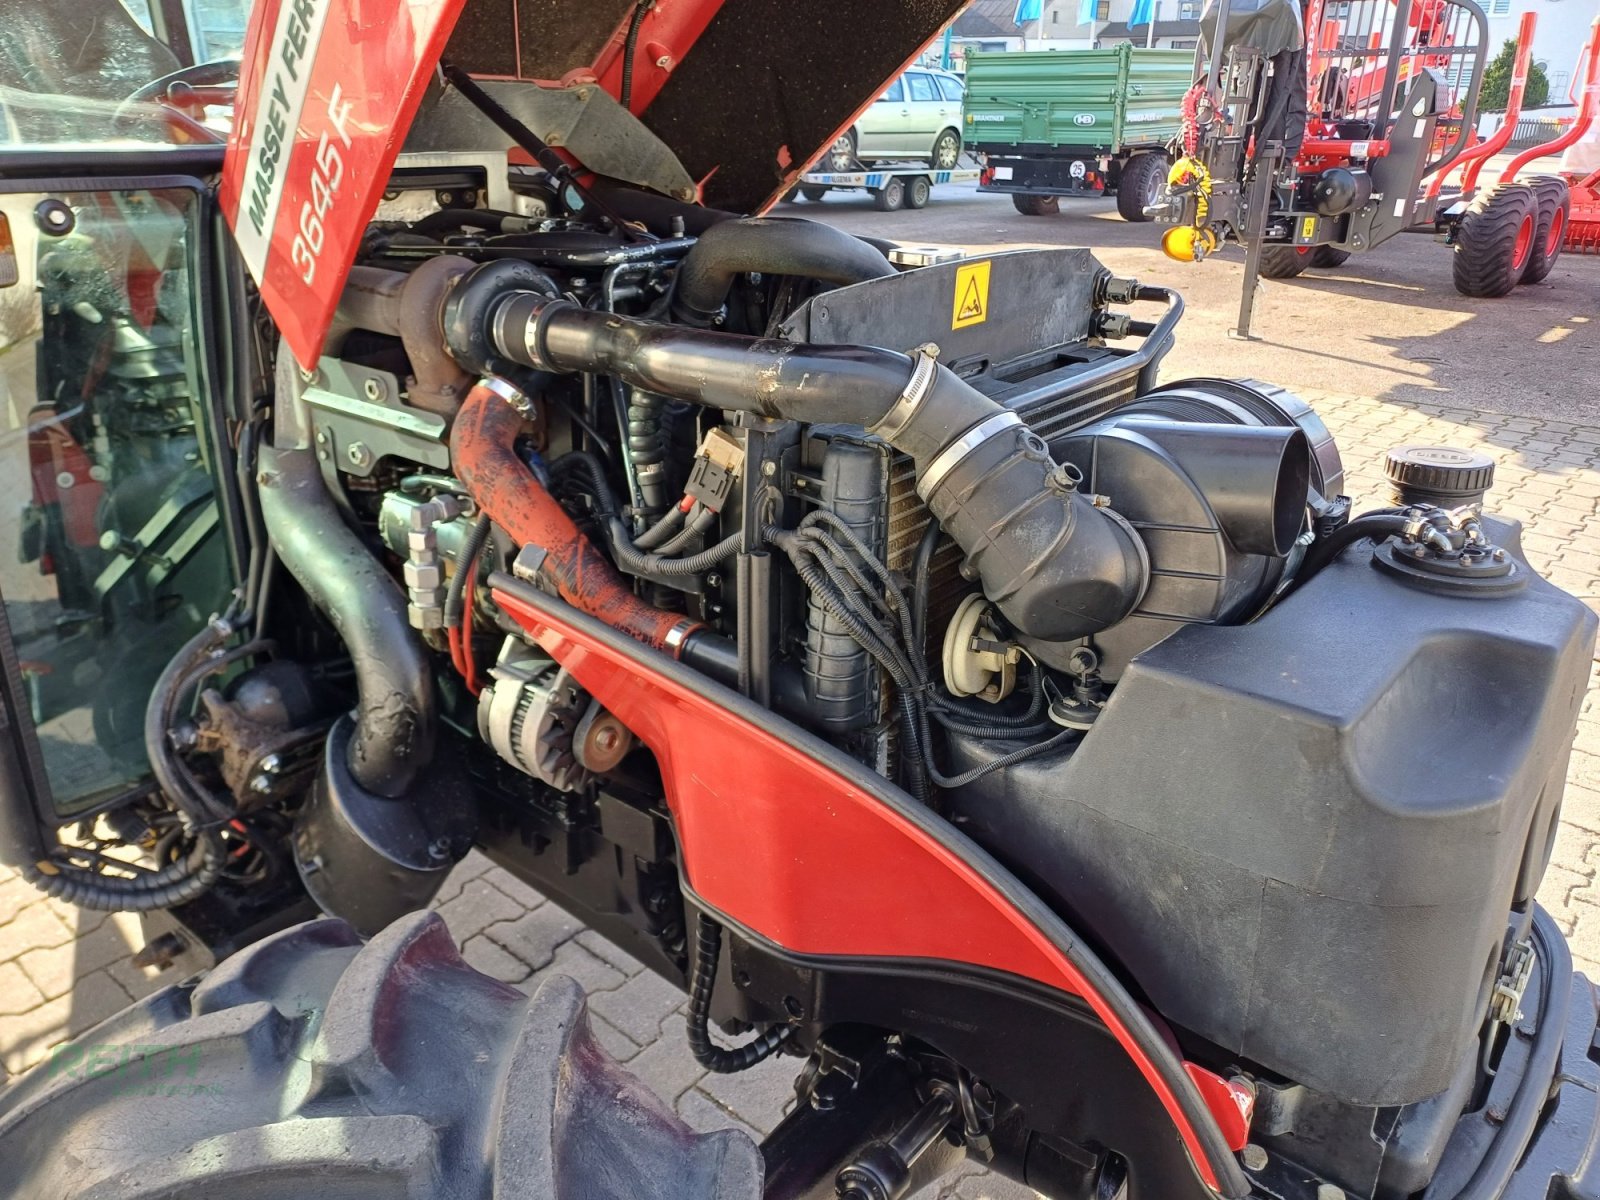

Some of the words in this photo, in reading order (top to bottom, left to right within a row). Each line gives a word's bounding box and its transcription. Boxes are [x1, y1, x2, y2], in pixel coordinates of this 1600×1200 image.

[248, 72, 291, 236] MASSEY
[281, 0, 317, 82] FER
[291, 130, 344, 286] 3645
[327, 82, 354, 149] F
[1072, 164, 1082, 175] 25
